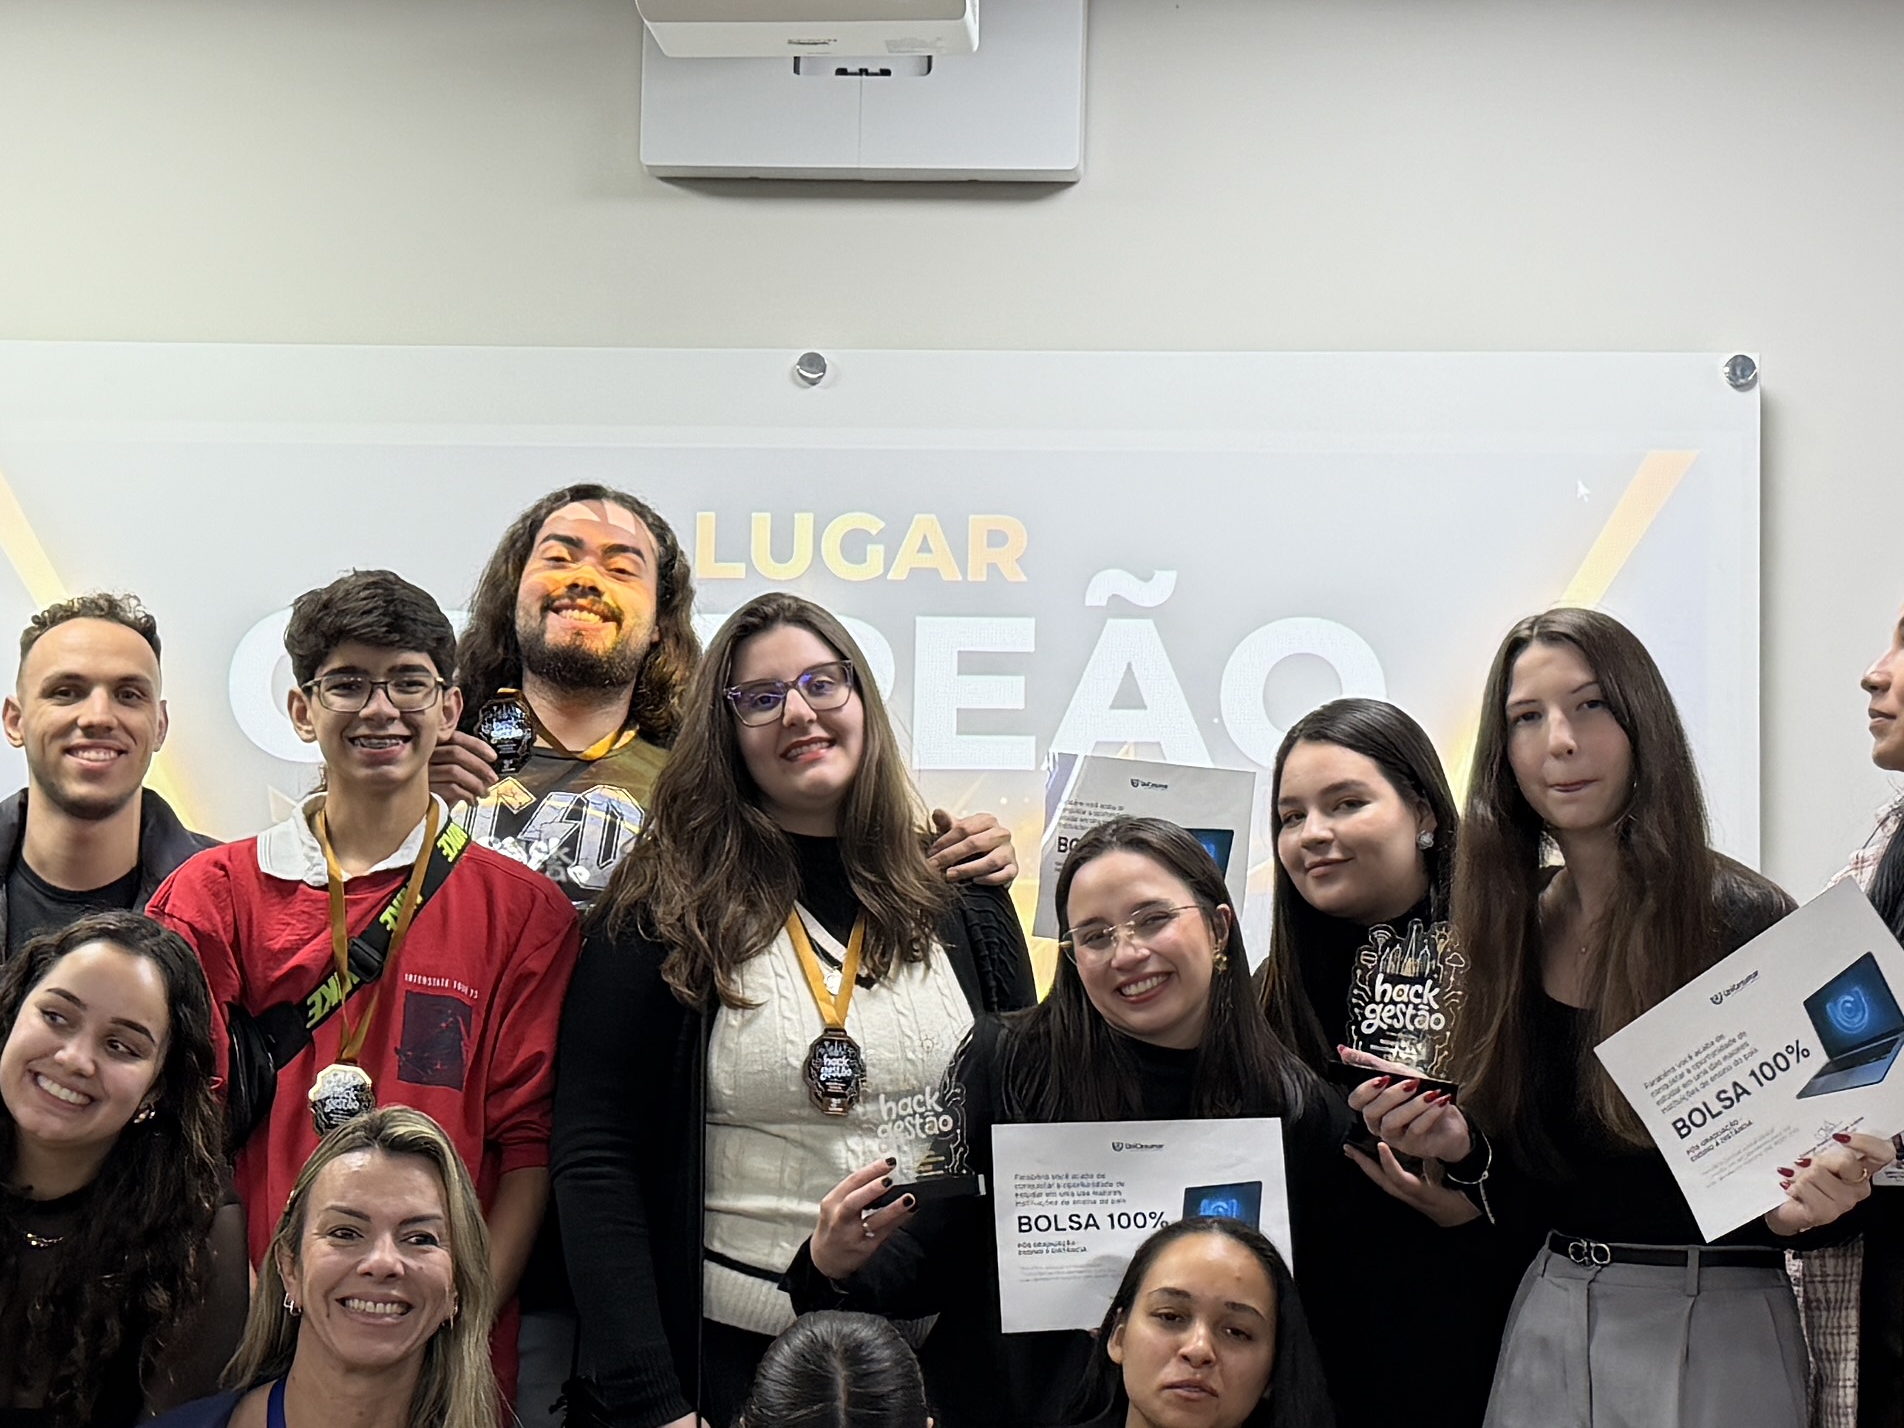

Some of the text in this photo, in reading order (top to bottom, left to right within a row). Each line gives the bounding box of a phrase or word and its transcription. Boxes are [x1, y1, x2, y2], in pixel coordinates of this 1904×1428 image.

[695, 511, 1028, 582] LUGAR
[226, 569, 1389, 776] CEÃO
[1374, 972, 1441, 1010] hack
[1360, 1003, 1446, 1035] gestão
[878, 1085, 944, 1122] hack
[1671, 1080, 1752, 1140] BOLSA
[1748, 1039, 1811, 1088] 100%
[1017, 1211, 1169, 1233] BOLSA 100%
